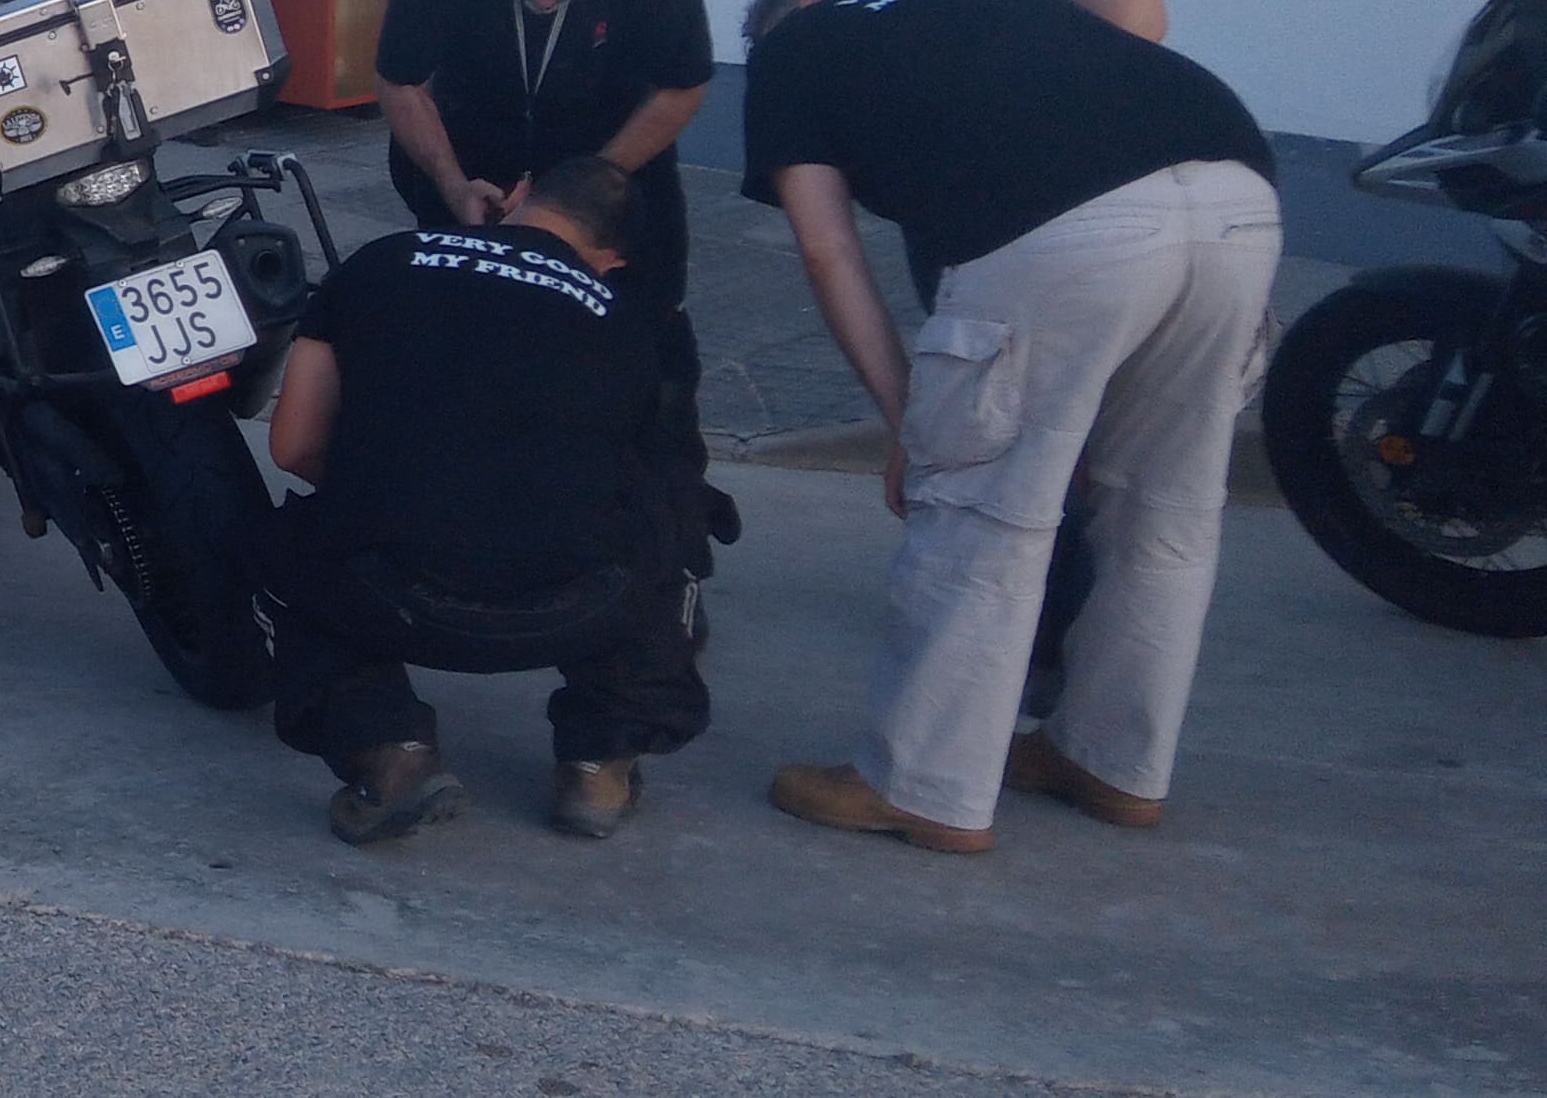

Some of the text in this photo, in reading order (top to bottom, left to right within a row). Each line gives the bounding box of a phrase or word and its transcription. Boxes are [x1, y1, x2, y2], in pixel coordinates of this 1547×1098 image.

[120, 261, 223, 323] 3655
[411, 251, 607, 317] MY FRIEND
[415, 232, 614, 301] VERY GOOD
[110, 324, 123, 340] E
[147, 310, 218, 366] JJS
